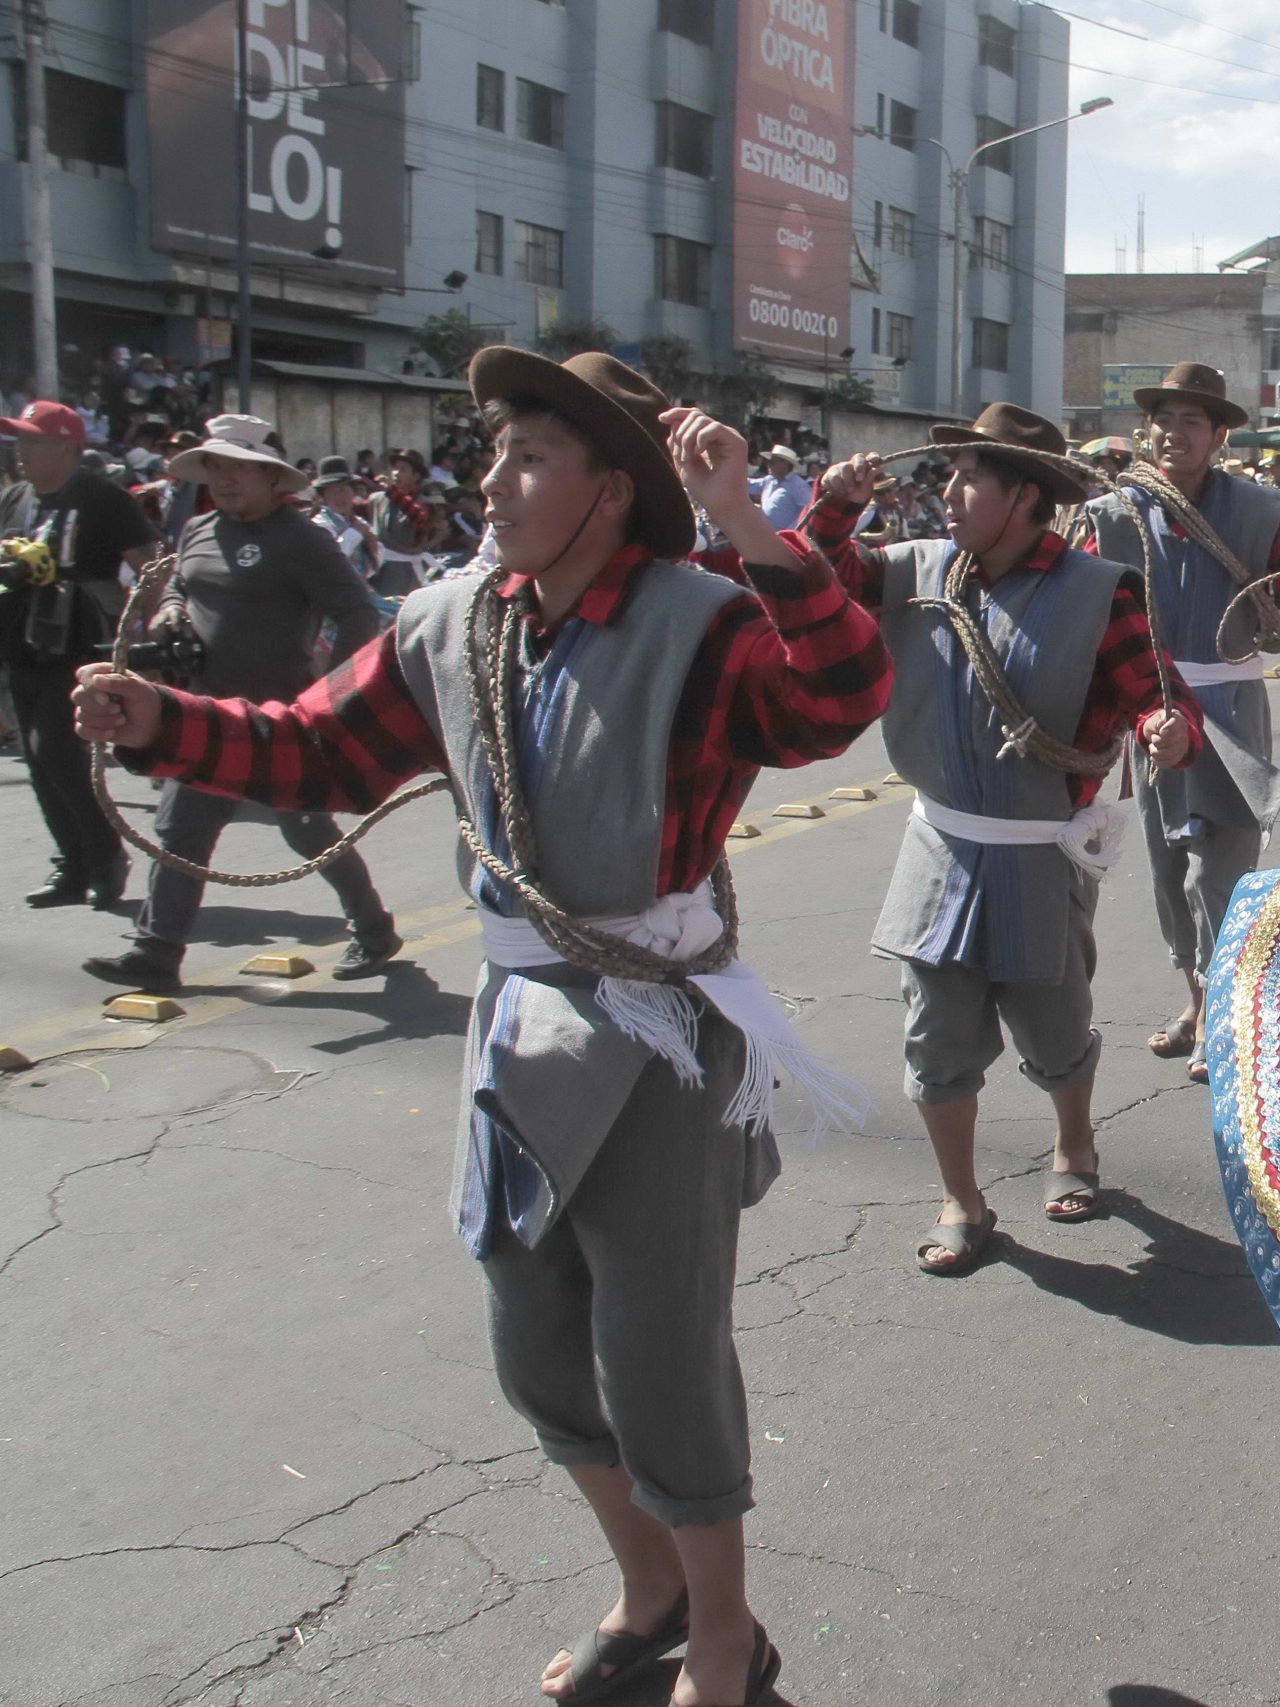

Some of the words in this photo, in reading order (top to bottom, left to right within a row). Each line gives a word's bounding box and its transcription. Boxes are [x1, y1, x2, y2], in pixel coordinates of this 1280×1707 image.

[234, 30, 325, 136] DE
[761, 17, 835, 94] ÓPTICA
[757, 112, 836, 165] VELOCIDAD
[788, 104, 808, 125] CON
[246, 124, 342, 249] LO!
[740, 138, 849, 201] ESTABILIDAD
[776, 227, 809, 252] Claro
[750, 297, 789, 329] 0800
